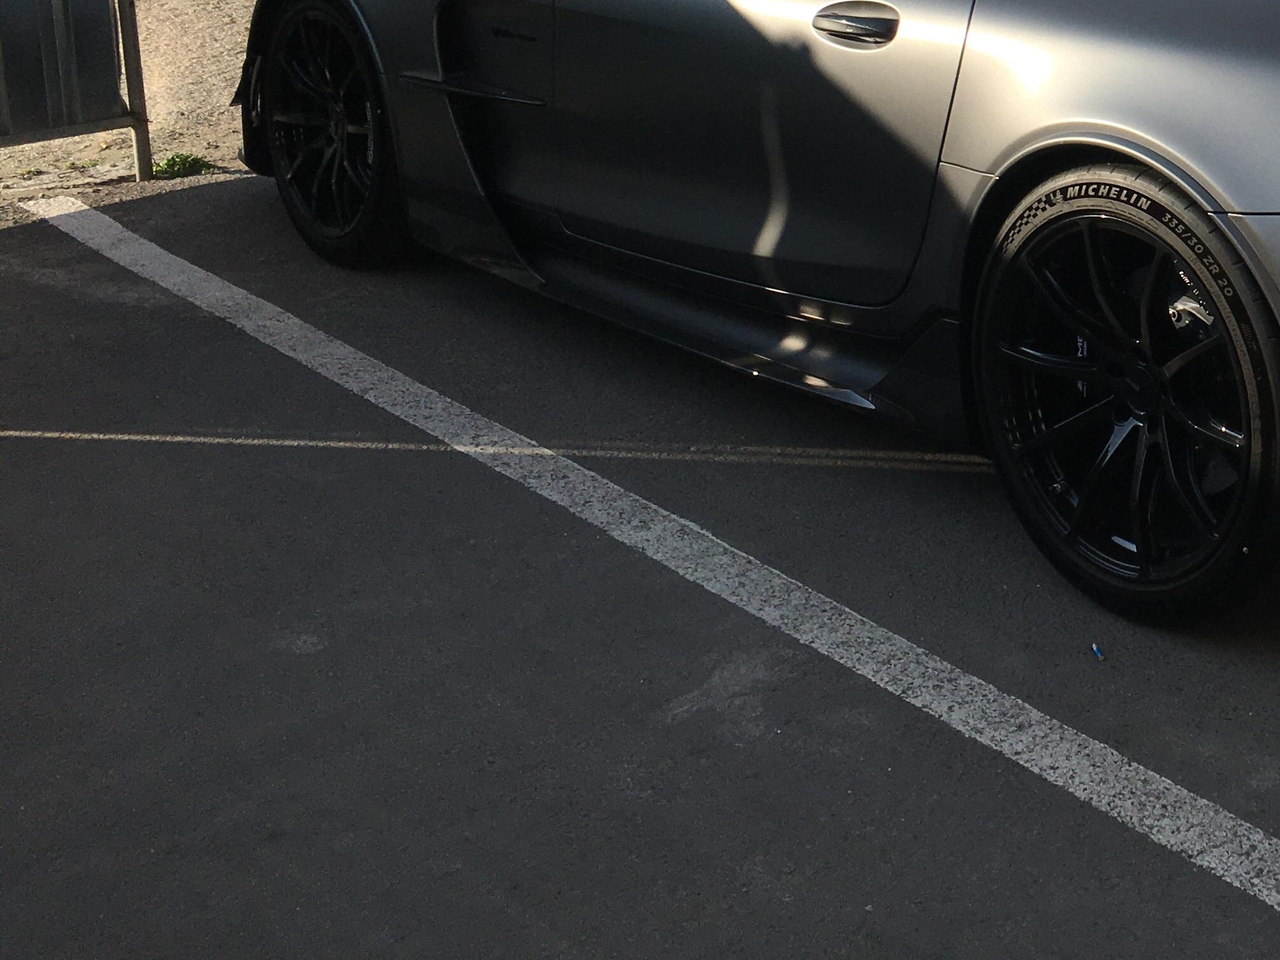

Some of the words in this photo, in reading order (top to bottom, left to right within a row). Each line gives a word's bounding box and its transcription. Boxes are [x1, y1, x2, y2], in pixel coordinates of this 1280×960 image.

[1067, 184, 1151, 210] MICHELIN
[1162, 213, 1204, 253] 335/30
[1202, 256, 1220, 274] ZR
[1217, 278, 1233, 296] 20
